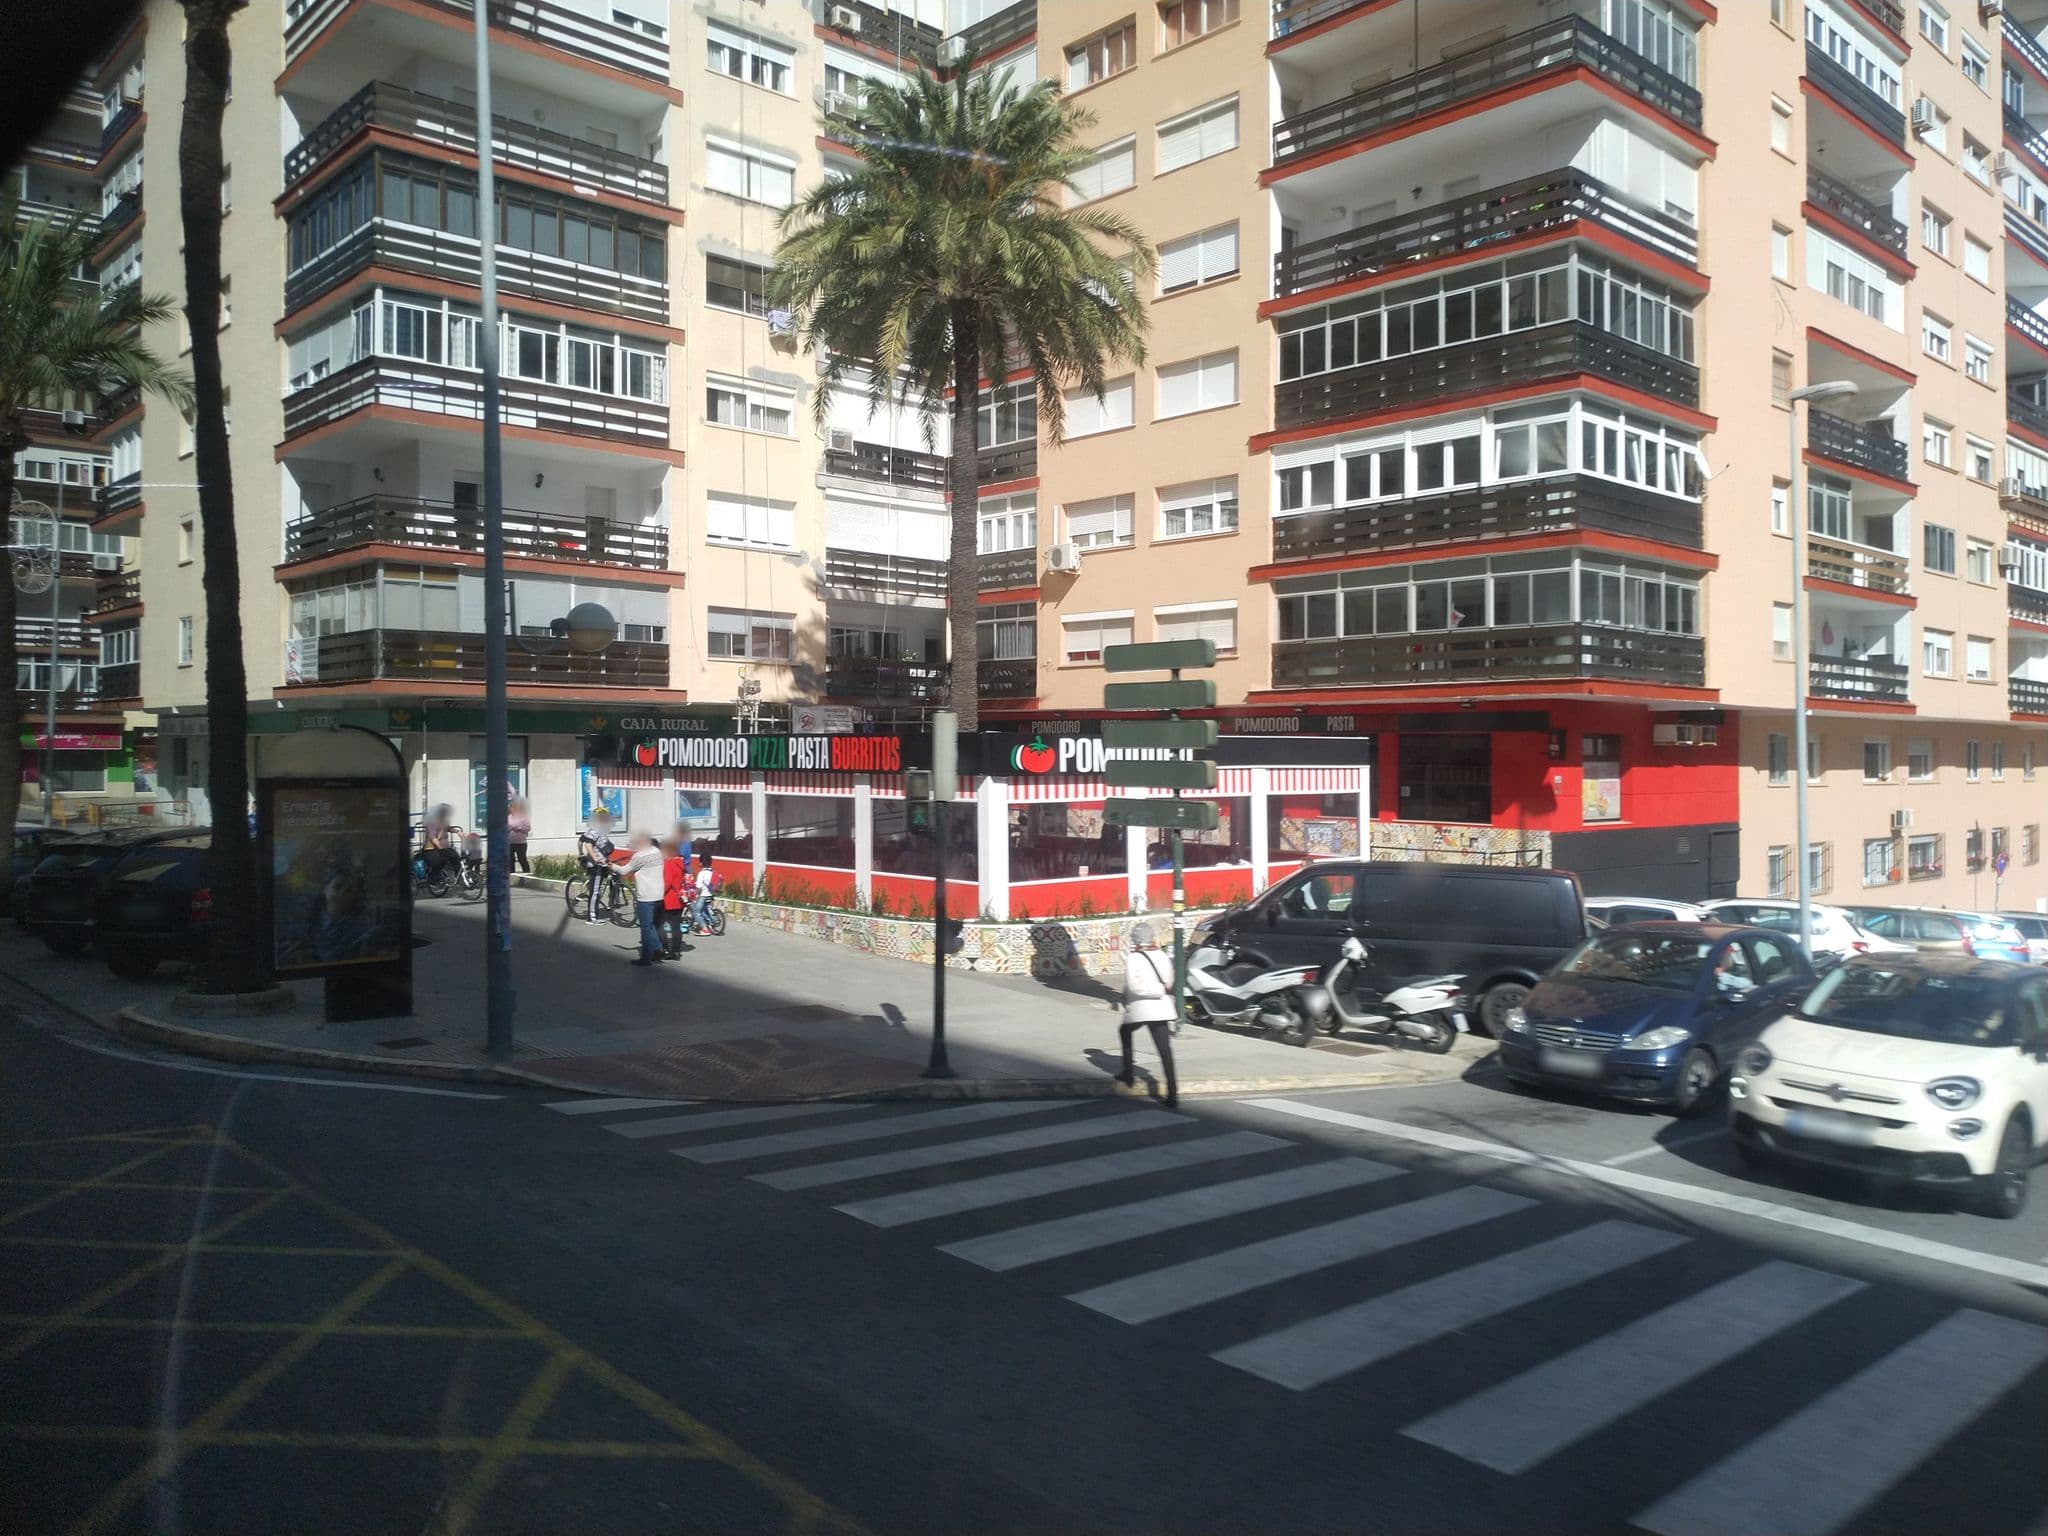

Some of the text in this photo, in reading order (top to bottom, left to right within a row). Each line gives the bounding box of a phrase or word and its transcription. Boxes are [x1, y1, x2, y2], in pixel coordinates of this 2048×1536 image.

[621, 717, 709, 731] CAJA RURAL
[1031, 720, 1081, 734] POMODORO
[1235, 717, 1300, 732] POMODORO
[1326, 716, 1355, 732] PASTA
[658, 736, 901, 771] POMODORO PIZZA PASTA BURRITOS
